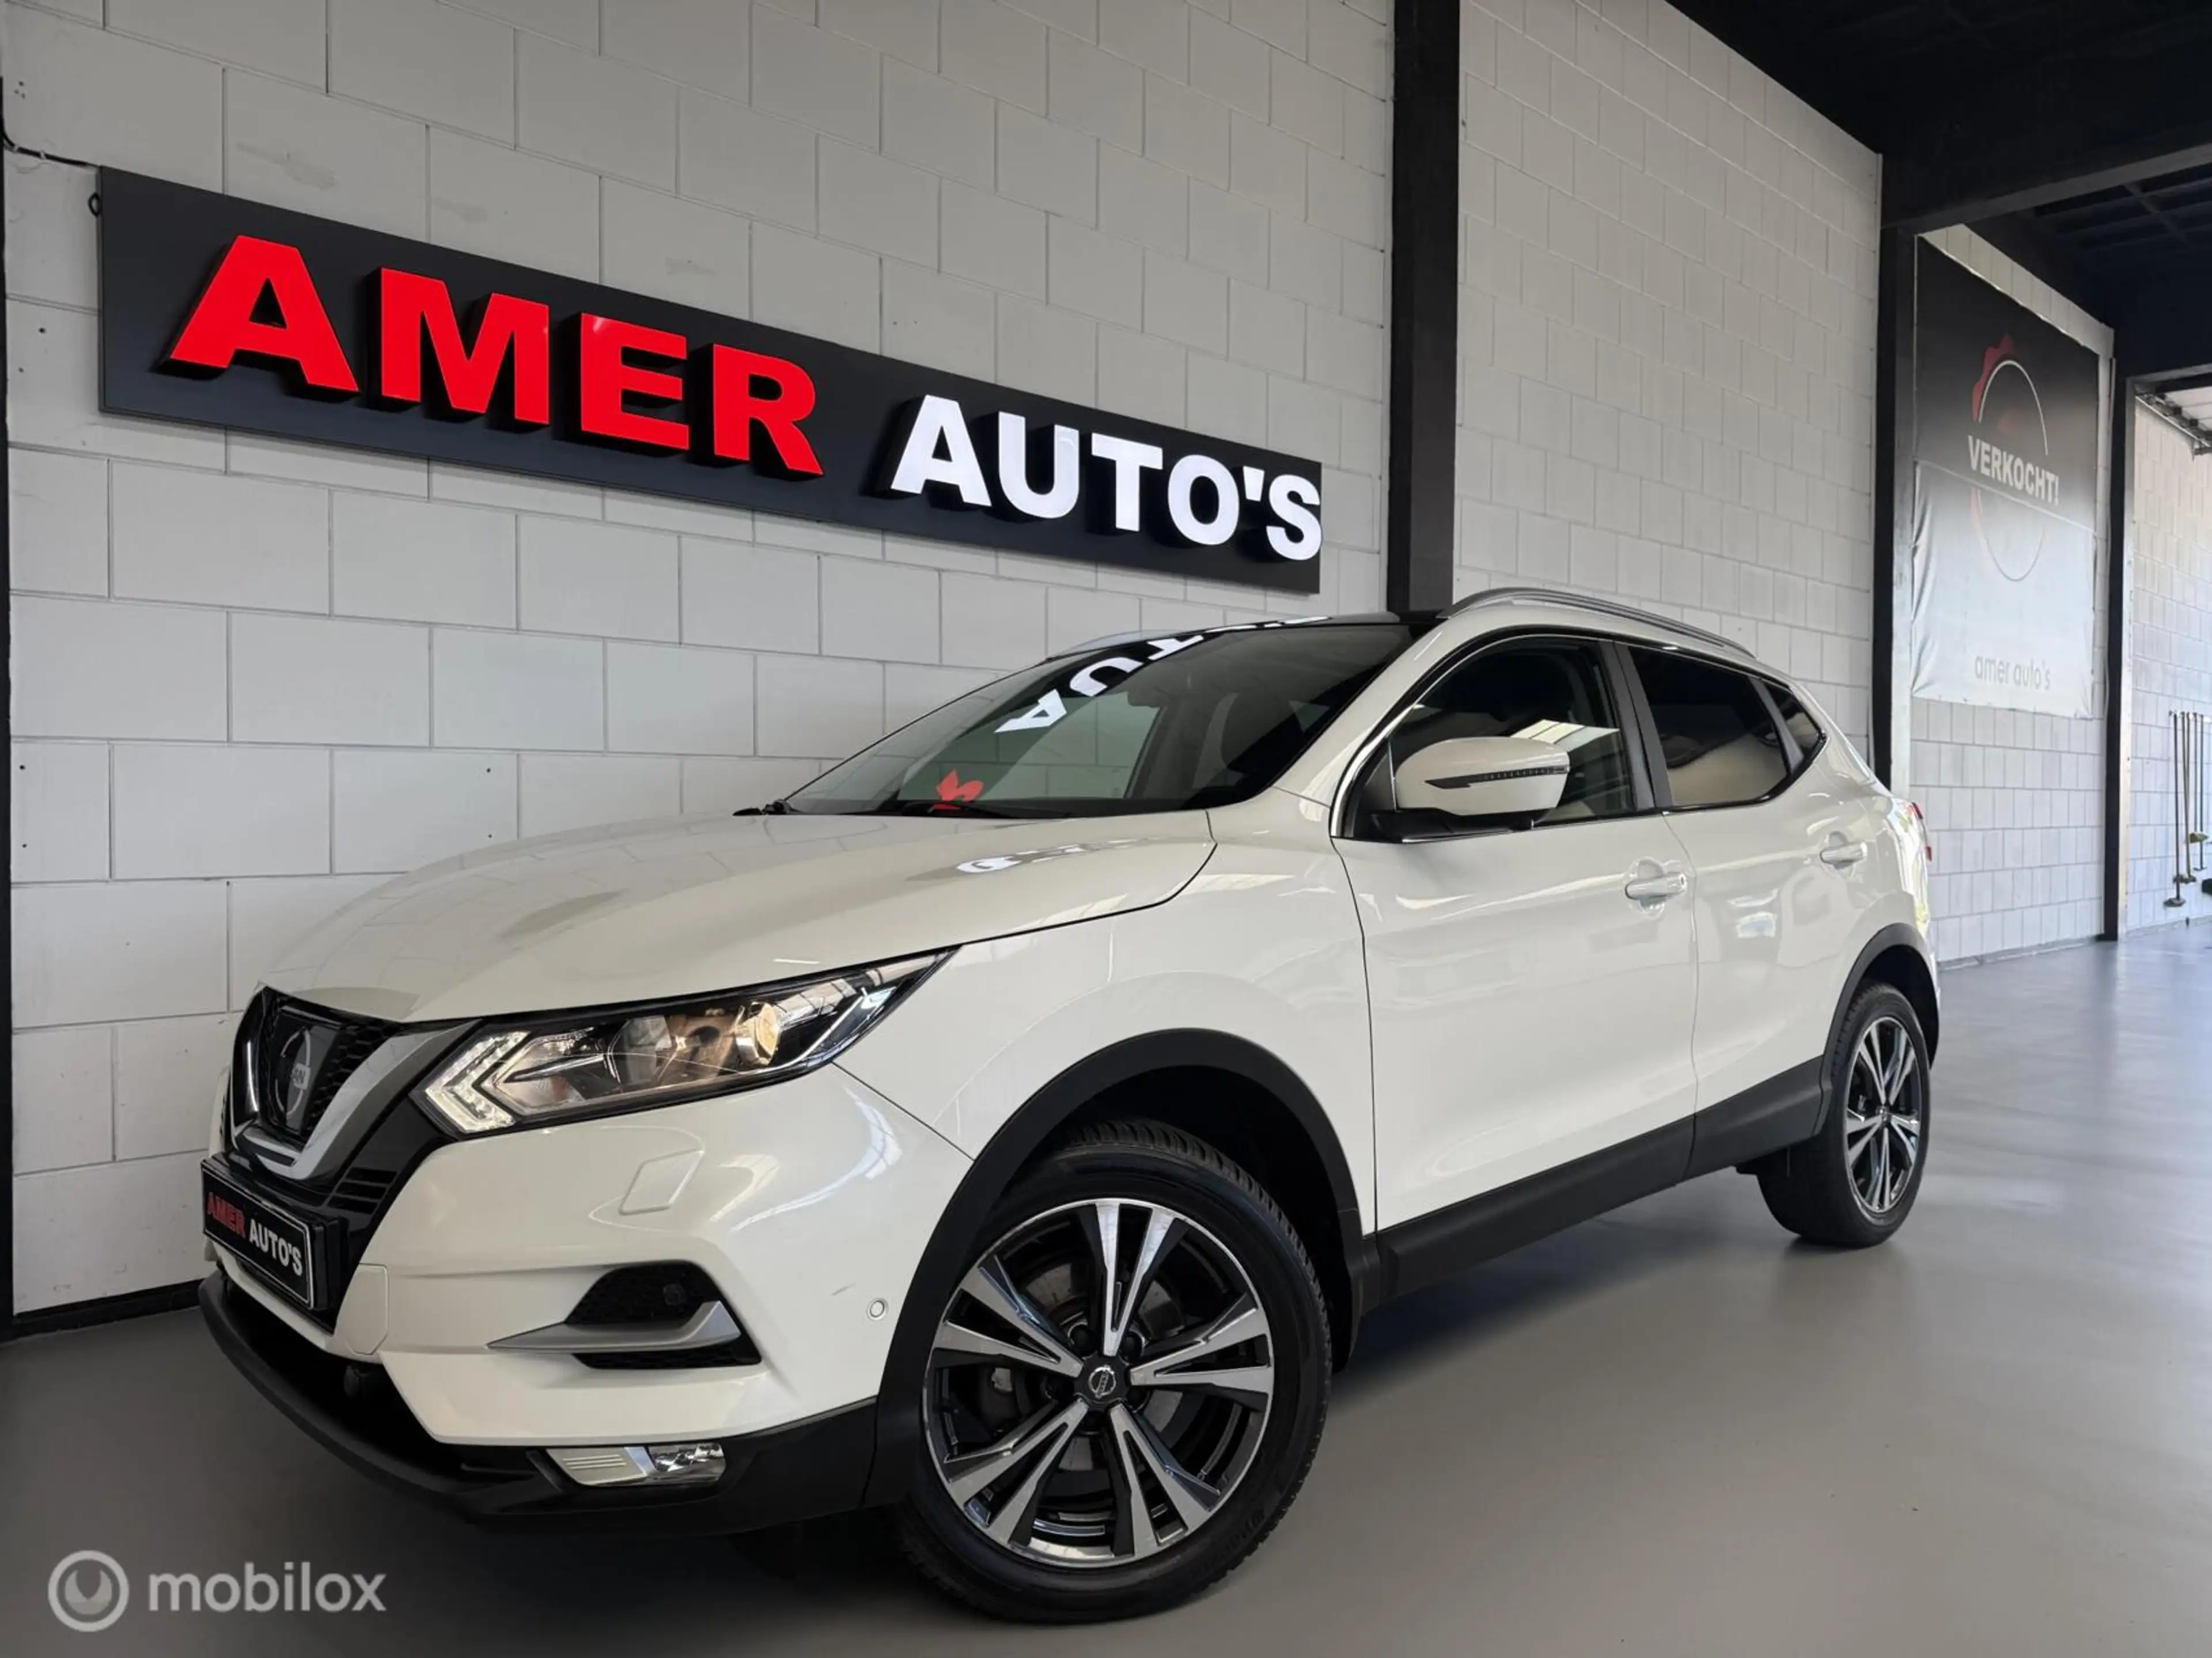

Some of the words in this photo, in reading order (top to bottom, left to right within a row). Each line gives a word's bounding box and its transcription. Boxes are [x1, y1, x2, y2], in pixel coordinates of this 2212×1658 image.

[167, 234, 824, 476] AMER
[890, 394, 1323, 561] AUTO'S
[1967, 435, 2059, 506] VERKOCHT!
[1974, 654, 2010, 684] amer
[2013, 657, 2051, 691] auto's
[207, 1192, 246, 1239] AMER
[248, 1218, 303, 1277] AUTO'S
